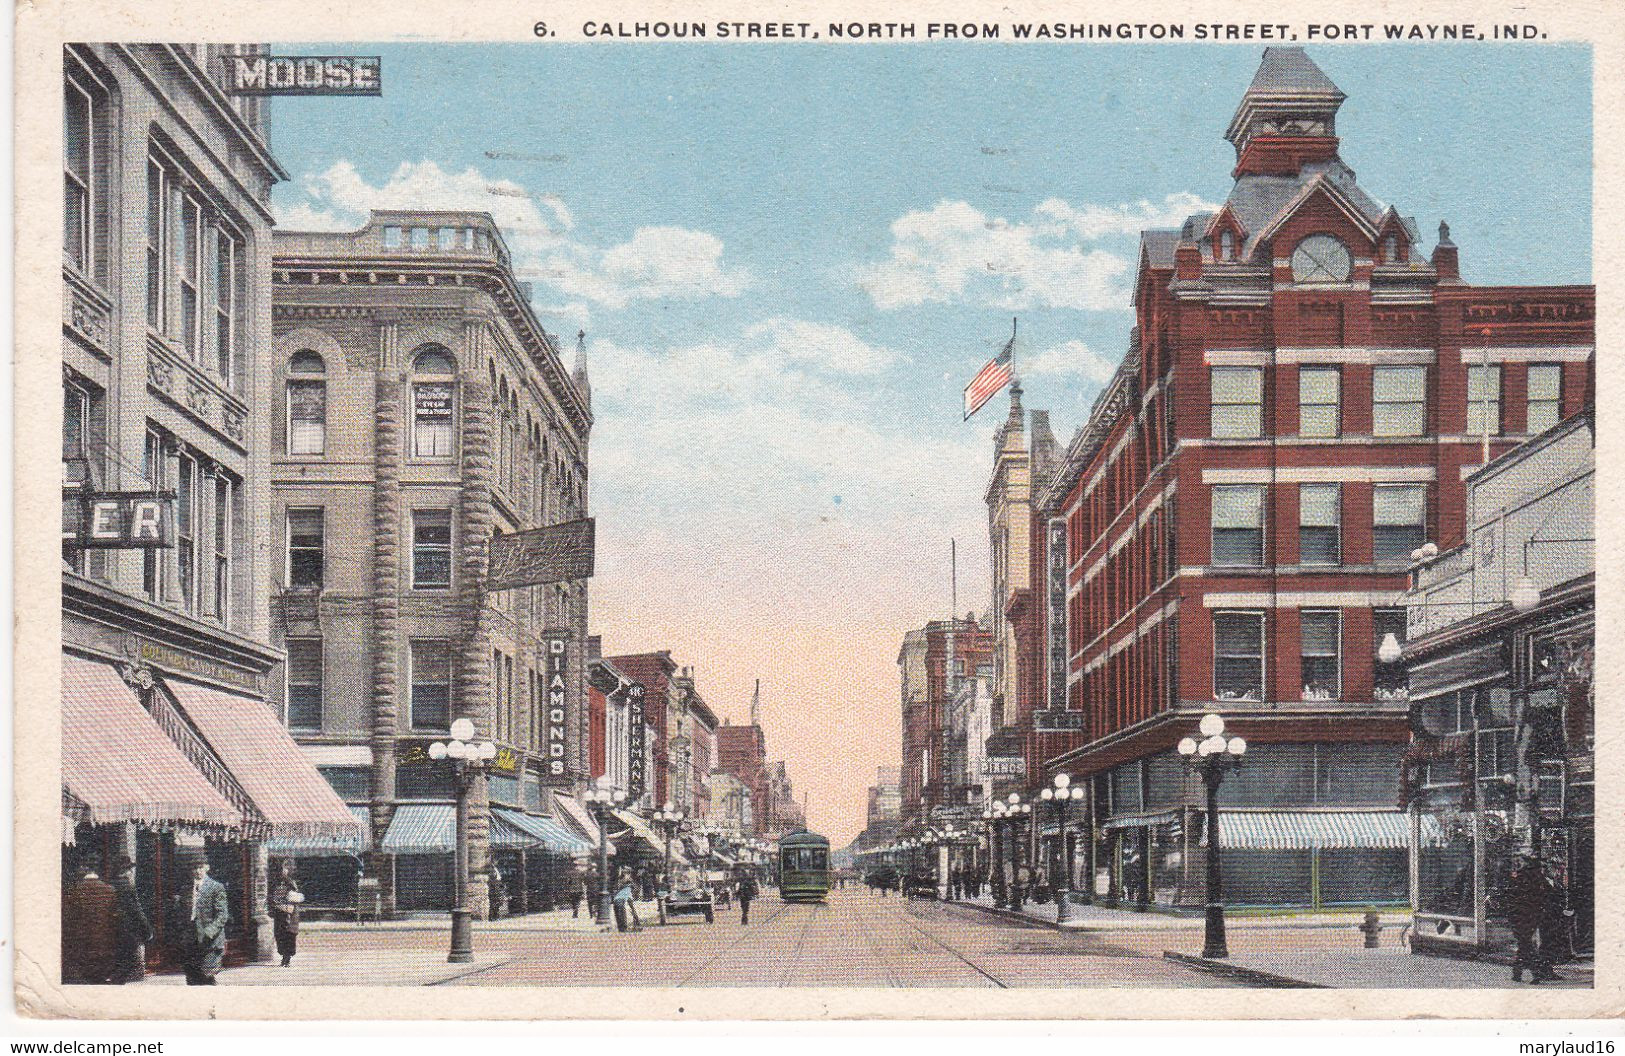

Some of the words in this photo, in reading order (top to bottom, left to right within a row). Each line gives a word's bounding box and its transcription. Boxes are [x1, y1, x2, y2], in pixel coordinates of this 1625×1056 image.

[533, 22, 555, 37] 6.
[582, 21, 706, 38] CALHOUN
[716, 22, 819, 40] STREET,
[829, 22, 915, 38] NORTH
[927, 23, 999, 38] FROM
[1012, 23, 1184, 39] WASHINGTON
[1194, 24, 1298, 41] STREET,
[1307, 24, 1374, 40] FORT
[1383, 24, 1486, 41] WAYNE,
[1494, 25, 1547, 39] IND.
[234, 57, 380, 88] MOOSE
[550, 639, 565, 775] DIAMONDS
[980, 762, 1026, 774] PIANOS
